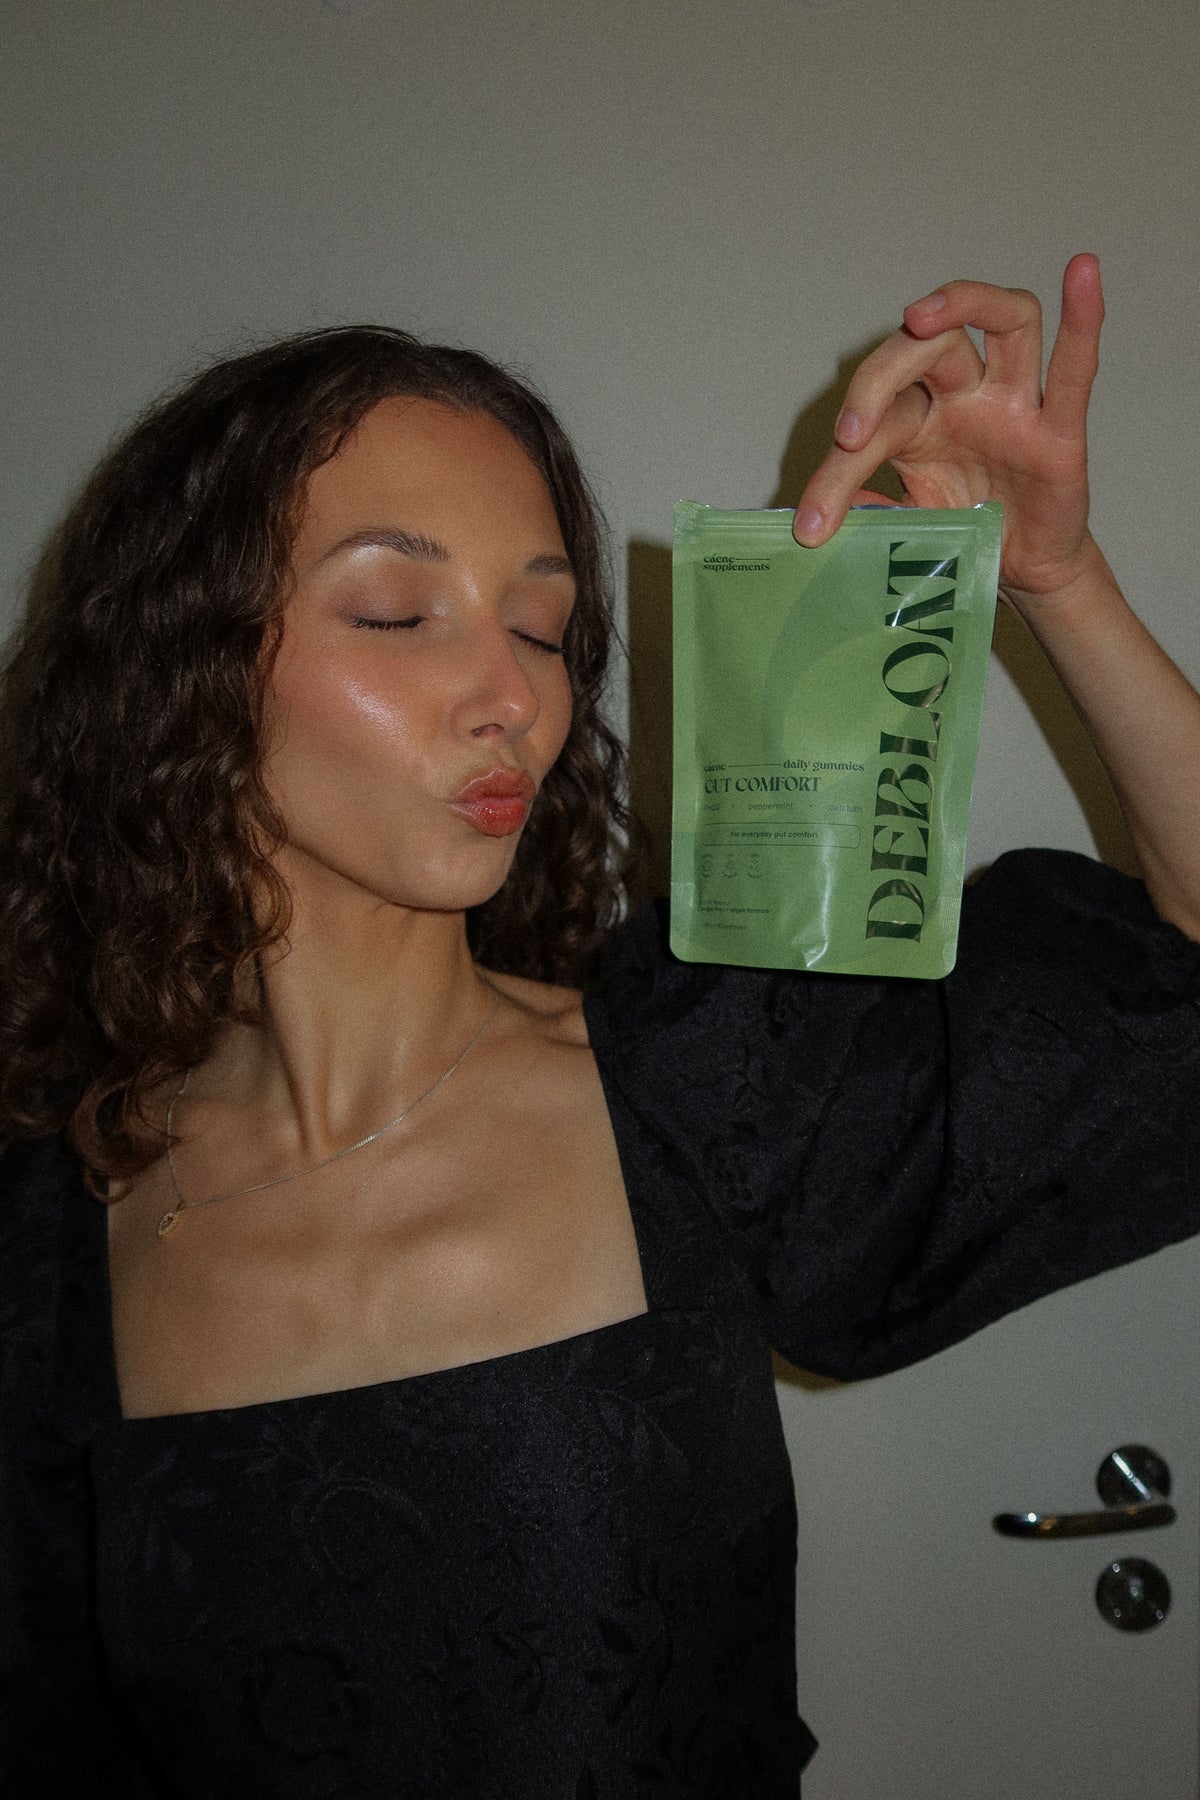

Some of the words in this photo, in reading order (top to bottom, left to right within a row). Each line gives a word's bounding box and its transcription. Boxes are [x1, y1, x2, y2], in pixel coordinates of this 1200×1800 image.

[703, 563, 771, 572] supplements
[866, 540, 958, 944] DEBLOAT
[783, 760, 809, 772] daily
[813, 761, 865, 772] gummies
[704, 777, 732, 794] GUT
[735, 776, 821, 793] COMFORT
[748, 802, 793, 811] peppermint
